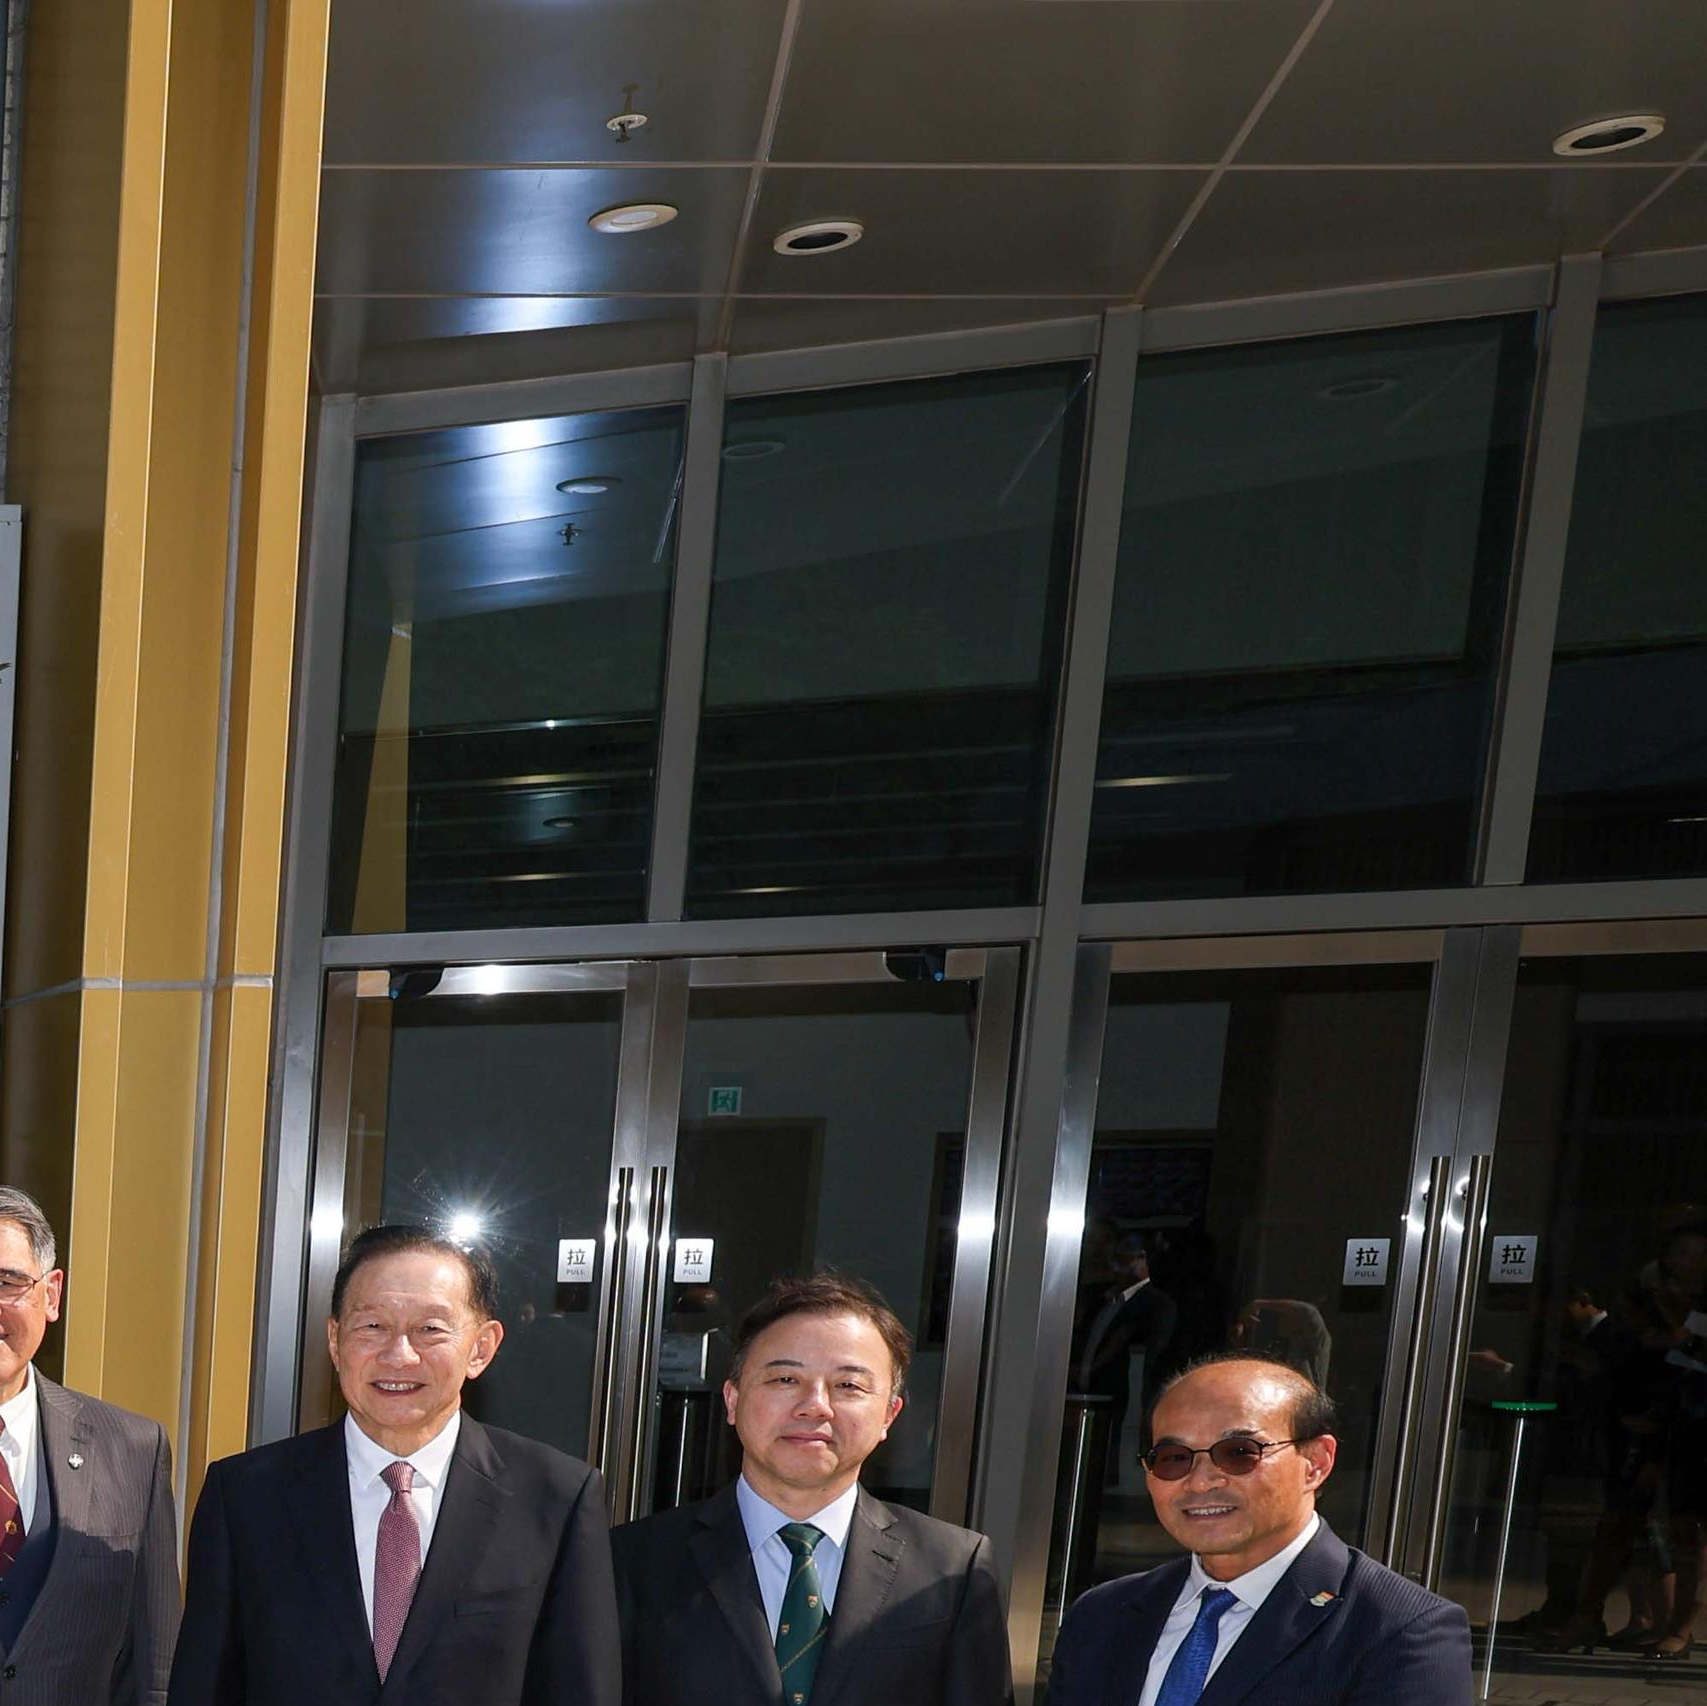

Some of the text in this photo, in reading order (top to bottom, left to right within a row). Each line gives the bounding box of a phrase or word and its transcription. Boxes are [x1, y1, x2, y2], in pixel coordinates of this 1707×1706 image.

[567, 1248, 586, 1265] 拉
[684, 1248, 703, 1265] 拉
[1356, 1247, 1379, 1267] 拉
[1502, 1244, 1526, 1265] 拉
